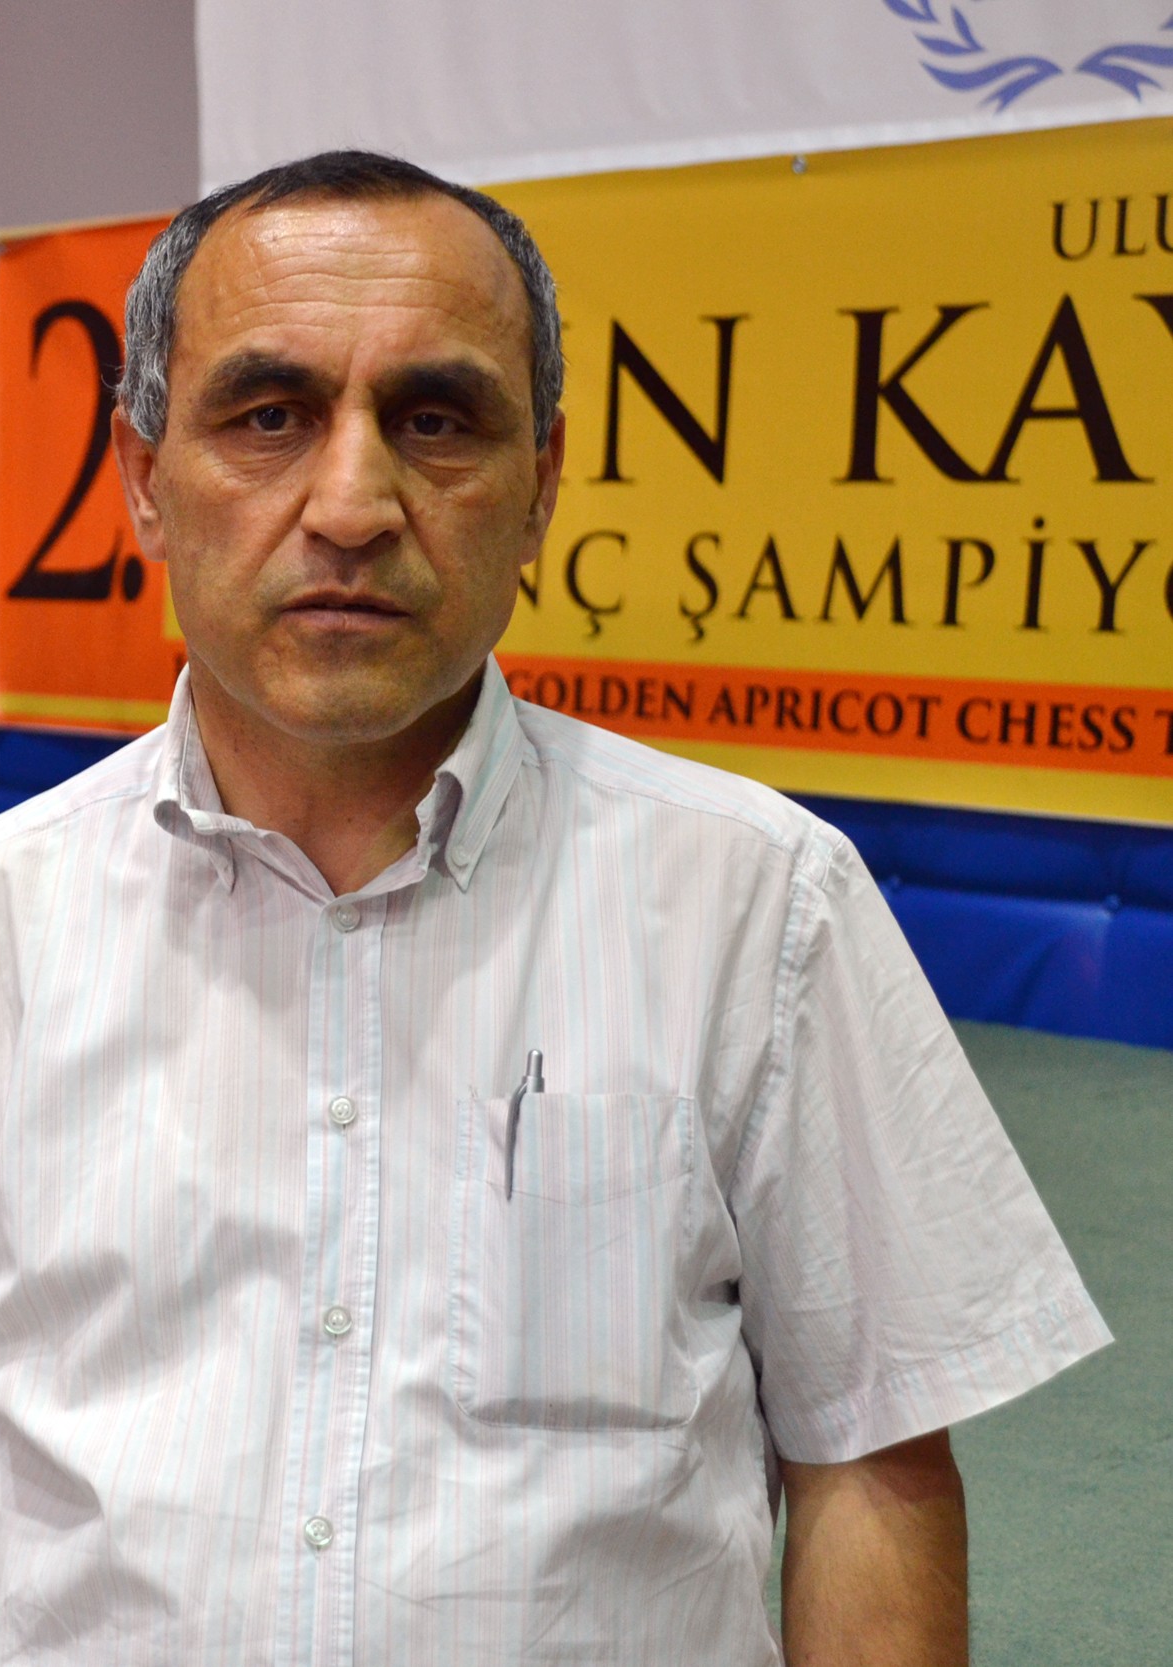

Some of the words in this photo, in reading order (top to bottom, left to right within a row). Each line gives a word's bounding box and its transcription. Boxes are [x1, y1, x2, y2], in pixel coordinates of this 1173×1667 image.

[8, 299, 145, 601] 2.
[560, 312, 750, 487] N
[679, 515, 1173, 644] ŞAMPİY
[707, 683, 942, 739] APRICOT
[955, 697, 1137, 755] CHESS
